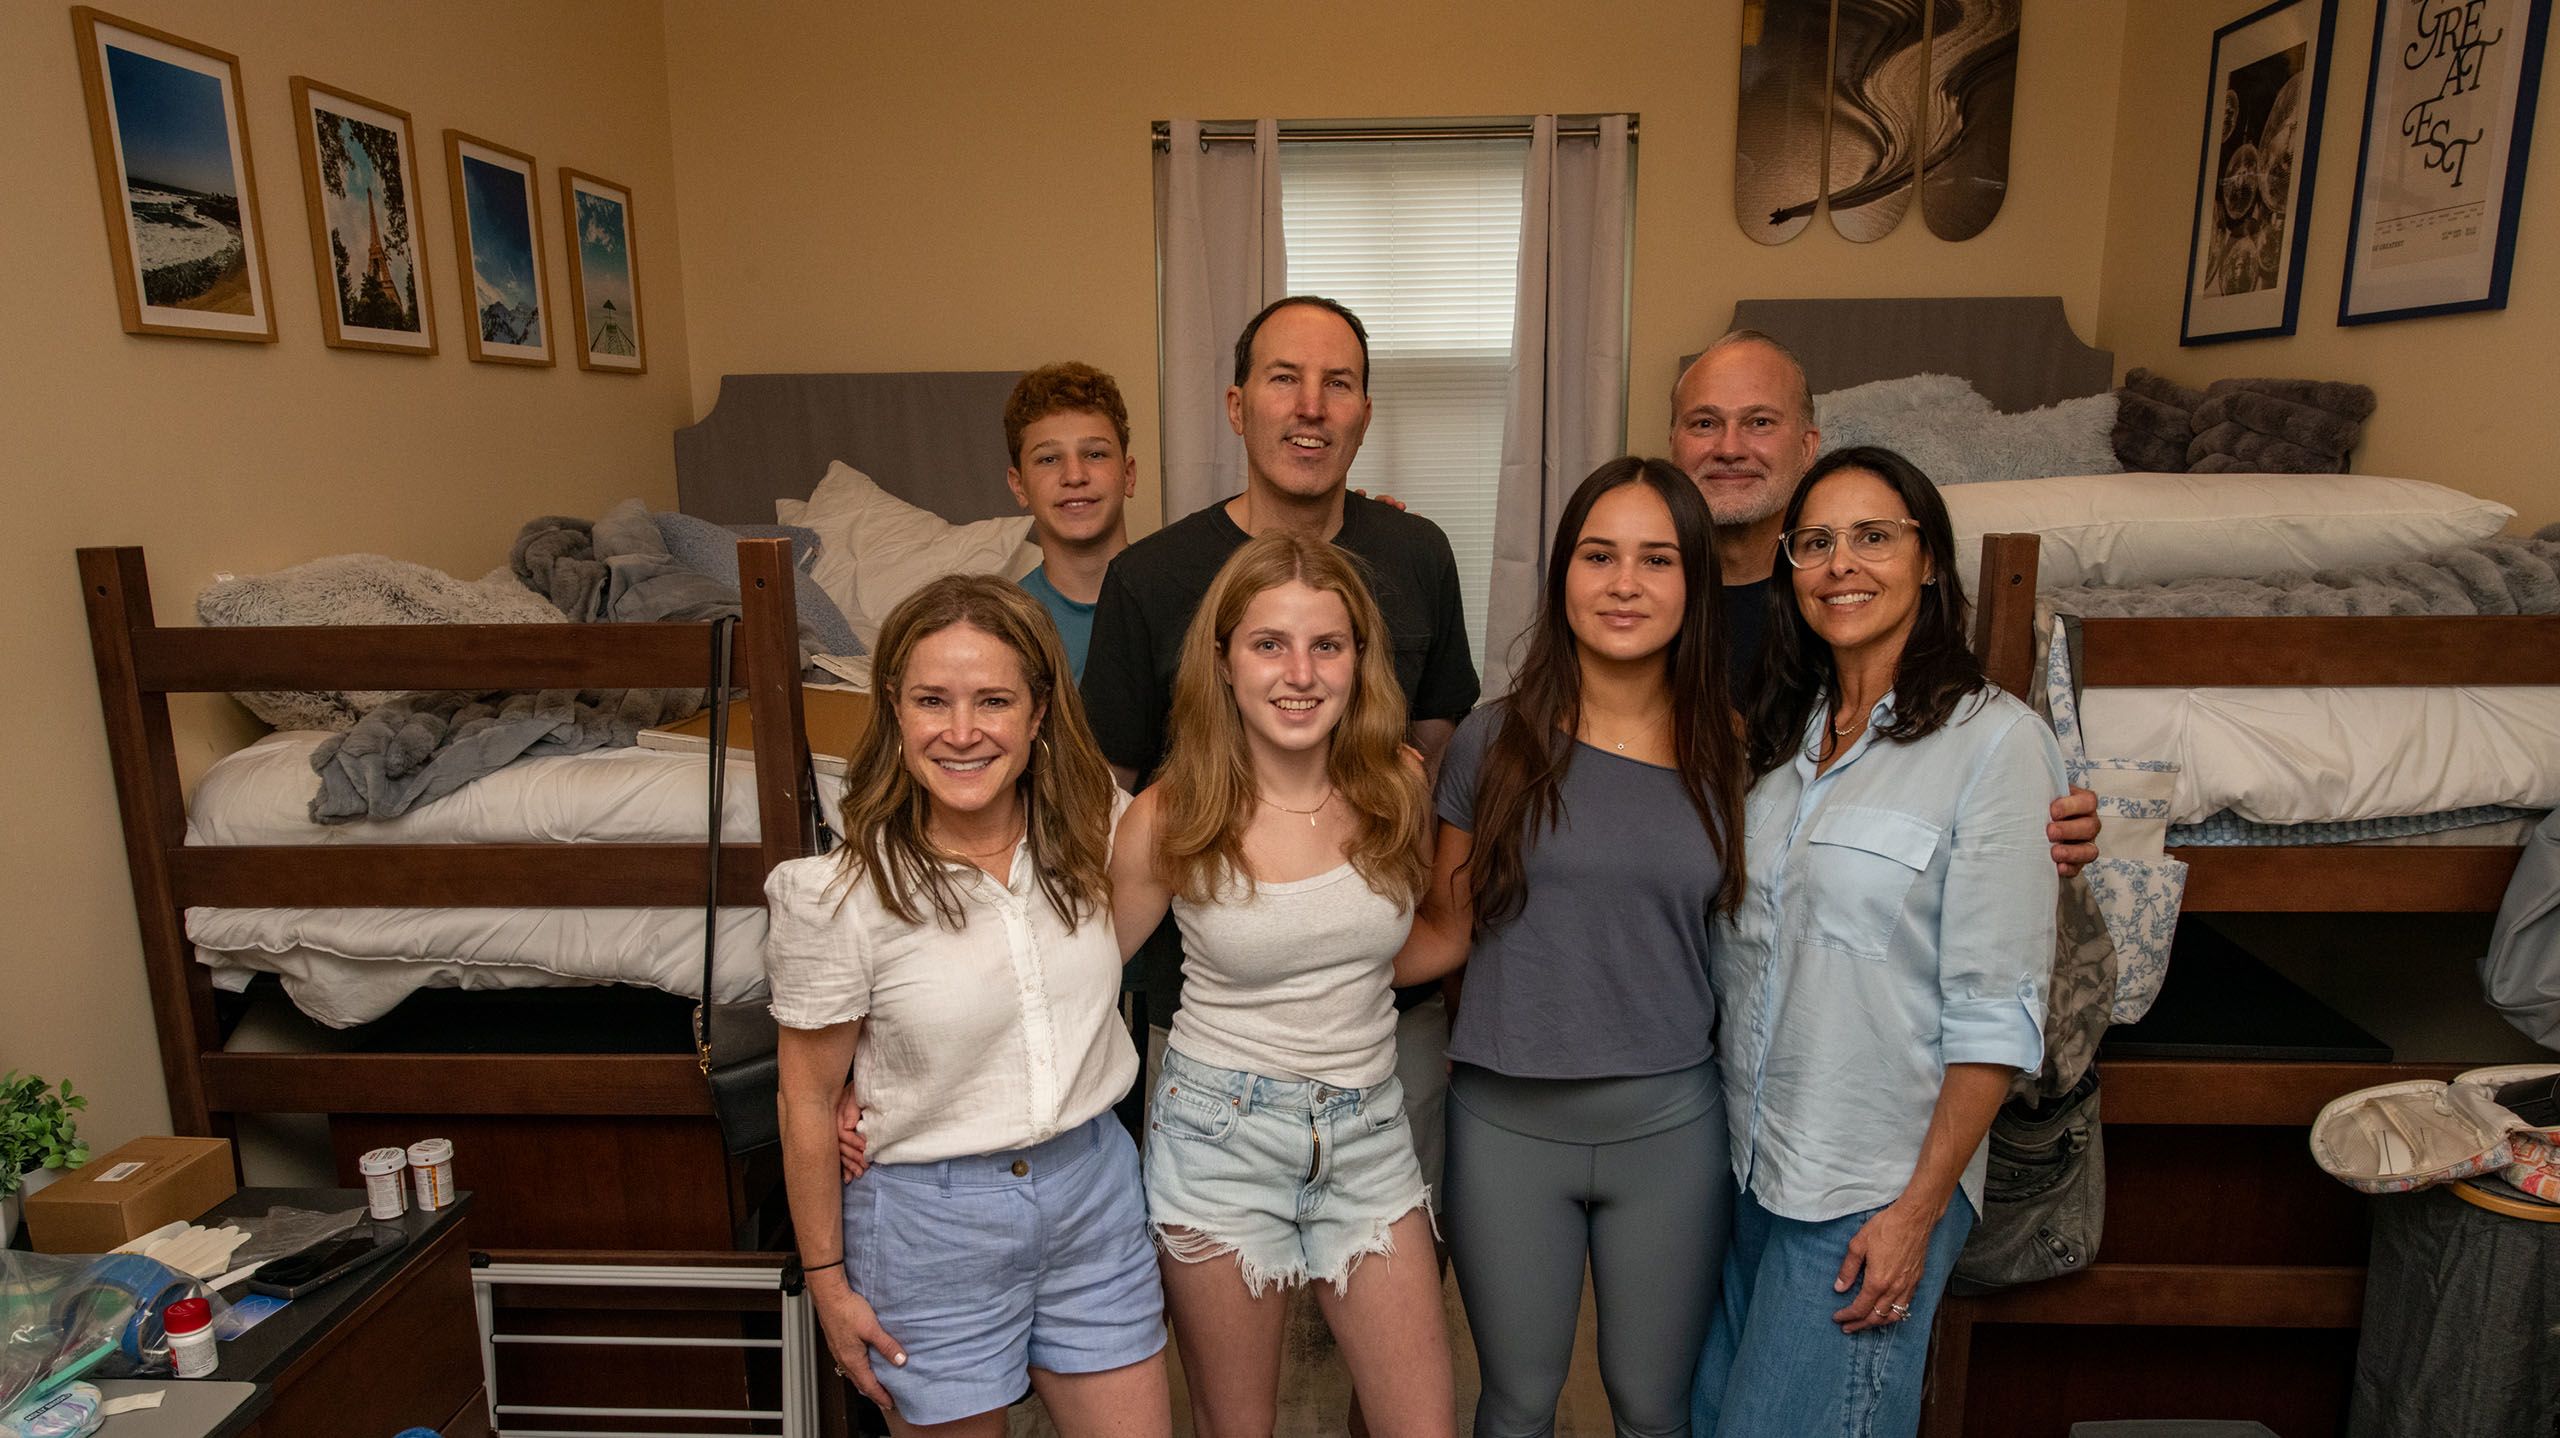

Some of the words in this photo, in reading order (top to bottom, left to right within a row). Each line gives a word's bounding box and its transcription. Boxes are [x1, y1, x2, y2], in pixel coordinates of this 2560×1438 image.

[2404, 0, 2486, 70] GRE
[2438, 28, 2503, 99] AT
[2402, 96, 2483, 188] EST
